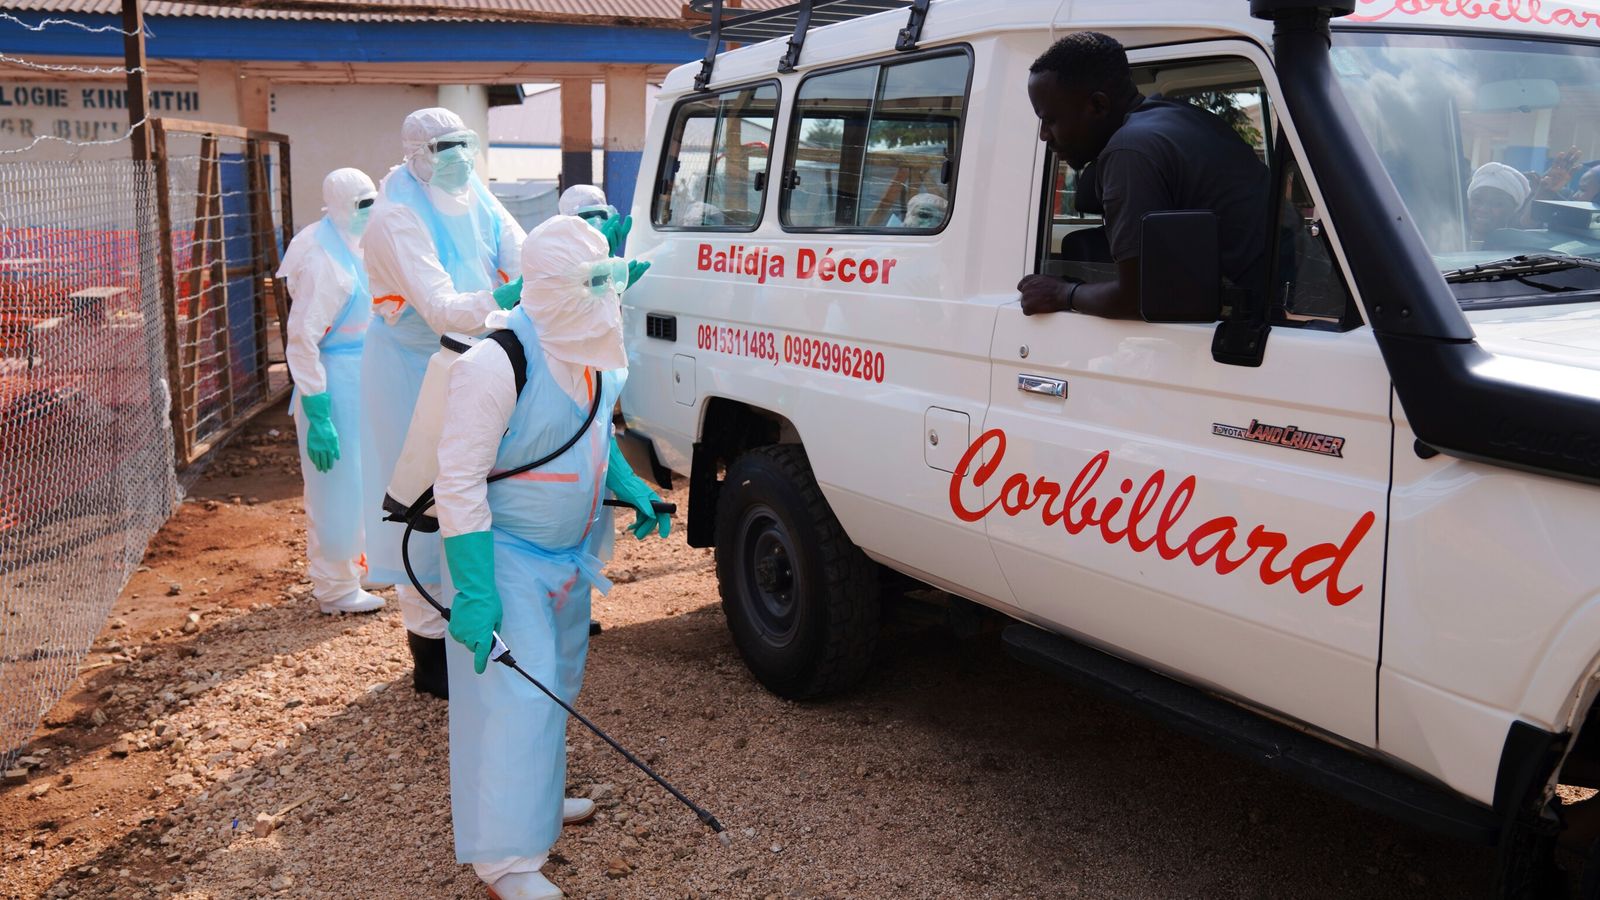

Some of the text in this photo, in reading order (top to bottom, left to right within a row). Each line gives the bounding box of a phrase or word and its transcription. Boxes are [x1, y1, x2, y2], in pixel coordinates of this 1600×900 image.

[697, 243, 897, 284] Balidja Décor
[697, 324, 885, 383] 0815311483, 0992996280
[1213, 424, 1243, 438] TOYOTA
[949, 428, 1375, 606] Corbillard
